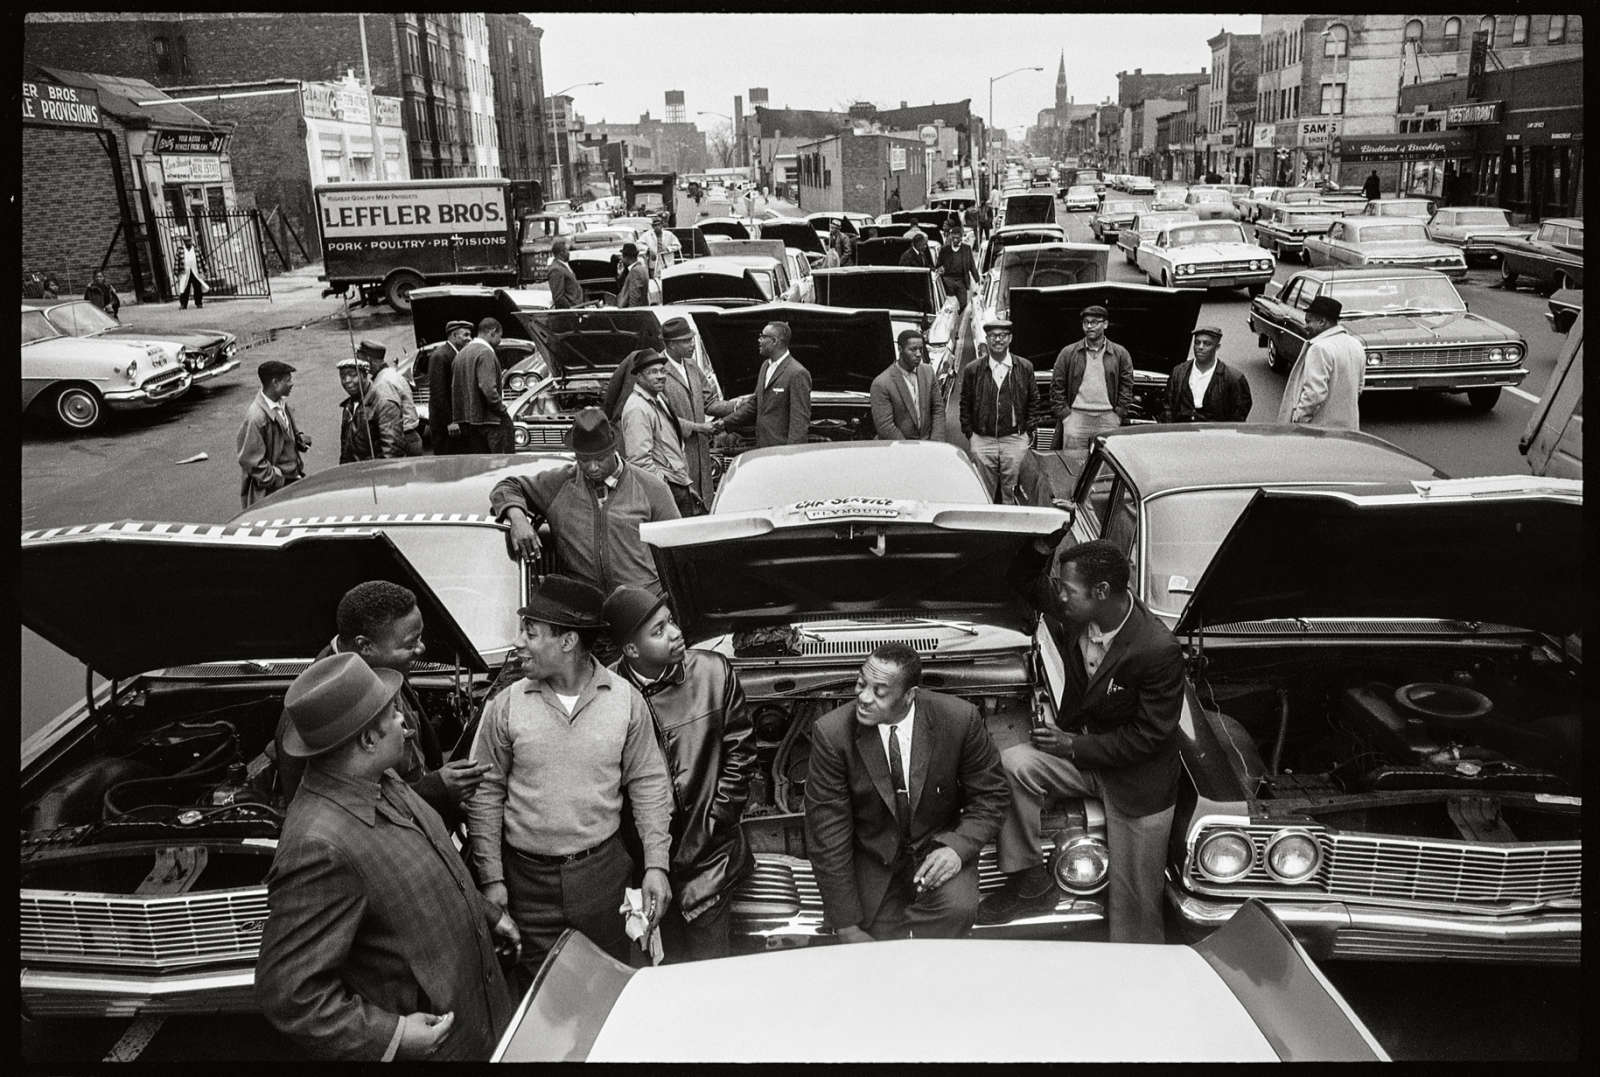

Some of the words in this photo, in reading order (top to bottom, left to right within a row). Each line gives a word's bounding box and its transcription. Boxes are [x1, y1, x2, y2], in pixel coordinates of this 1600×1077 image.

[23, 83, 39, 97] ER
[48, 85, 79, 102] BROS.
[41, 100, 98, 123] PROVISIONS
[1447, 104, 1497, 122] RESTAURANT
[1303, 123, 1337, 134] SAM'S
[324, 205, 431, 228] LEFFLER
[438, 202, 504, 224] BROS.
[328, 242, 362, 251] PORK
[370, 240, 425, 249] POULTRY
[433, 236, 507, 247] PRVISIONS
[812, 508, 894, 516] PLYMOUTH
